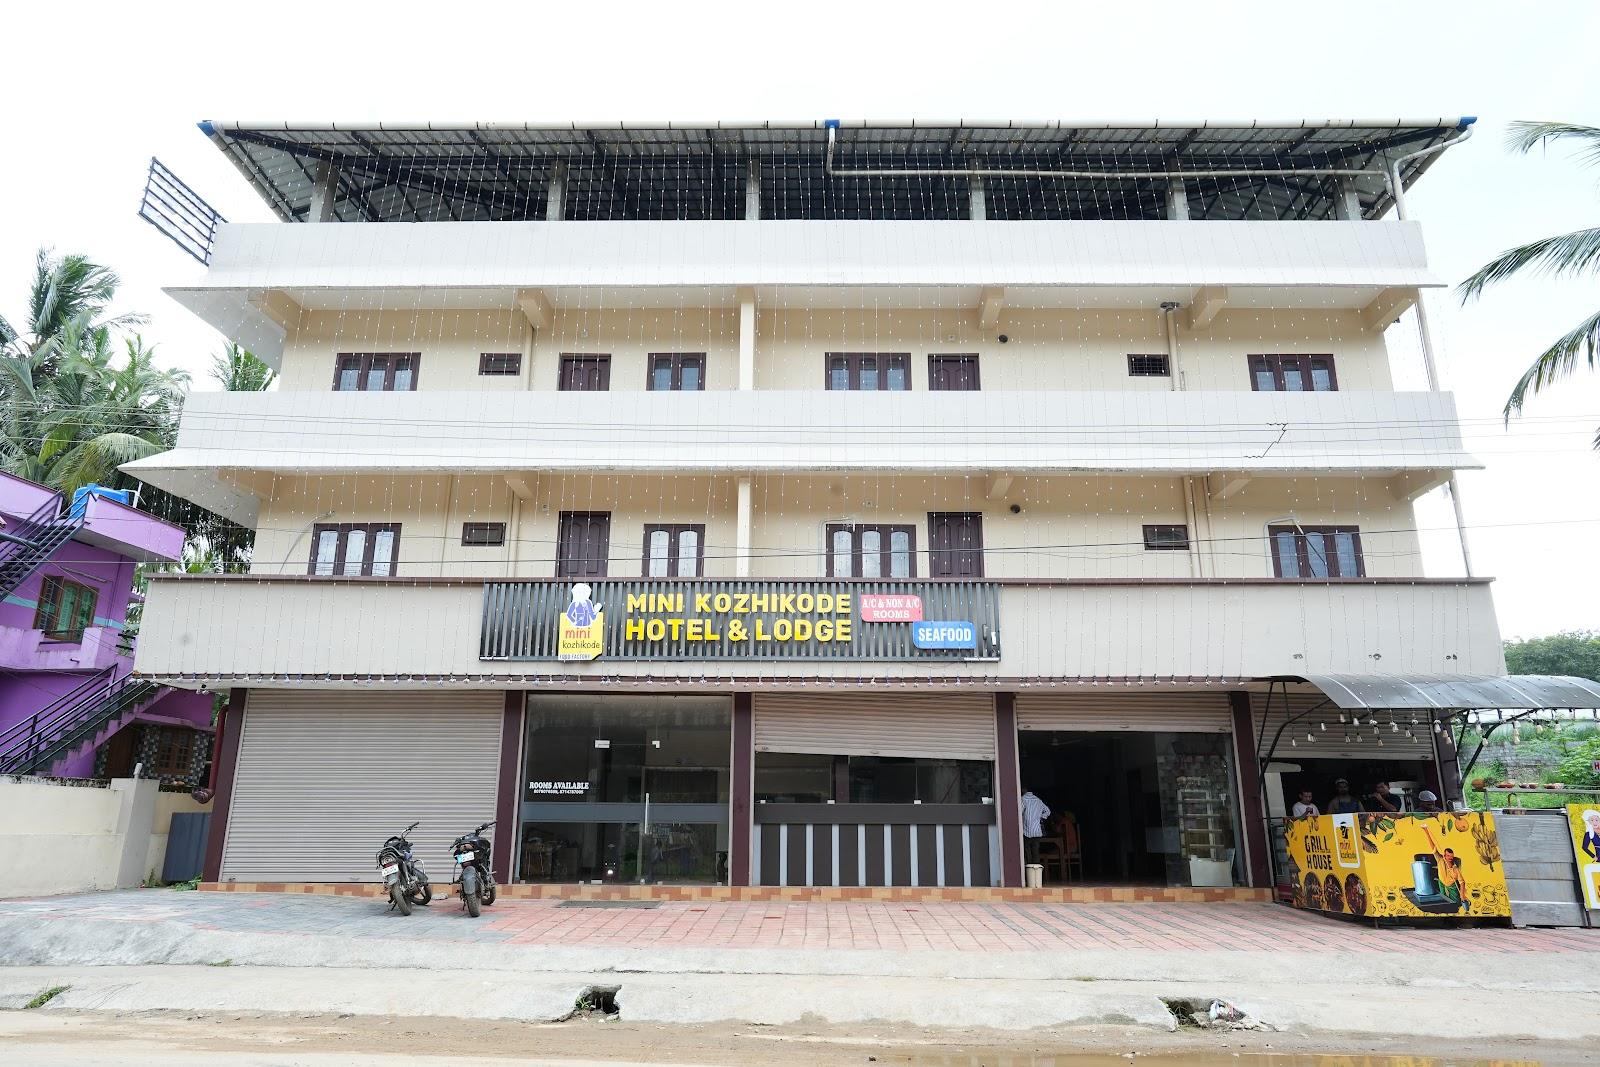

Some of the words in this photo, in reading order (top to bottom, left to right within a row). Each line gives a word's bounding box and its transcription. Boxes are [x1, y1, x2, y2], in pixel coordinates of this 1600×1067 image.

[626, 593, 684, 613] MINI
[695, 593, 852, 614] KOZHIKODE
[862, 598, 877, 608] A/C
[878, 599, 885, 609] &
[886, 598, 901, 609] NON
[905, 598, 921, 609] A/C
[873, 610, 910, 618] ROOMS
[565, 627, 591, 639] mini
[625, 618, 721, 641] HOTEL
[727, 619, 749, 641] &
[755, 618, 852, 642] LODGE
[918, 627, 972, 642] SEAFOOD
[562, 640, 600, 649] kozhikode
[529, 781, 552, 789] ROOMS
[553, 781, 589, 789] AVAILABLE
[1304, 835, 1329, 852] GRILL
[1306, 854, 1333, 870] HOUSE
